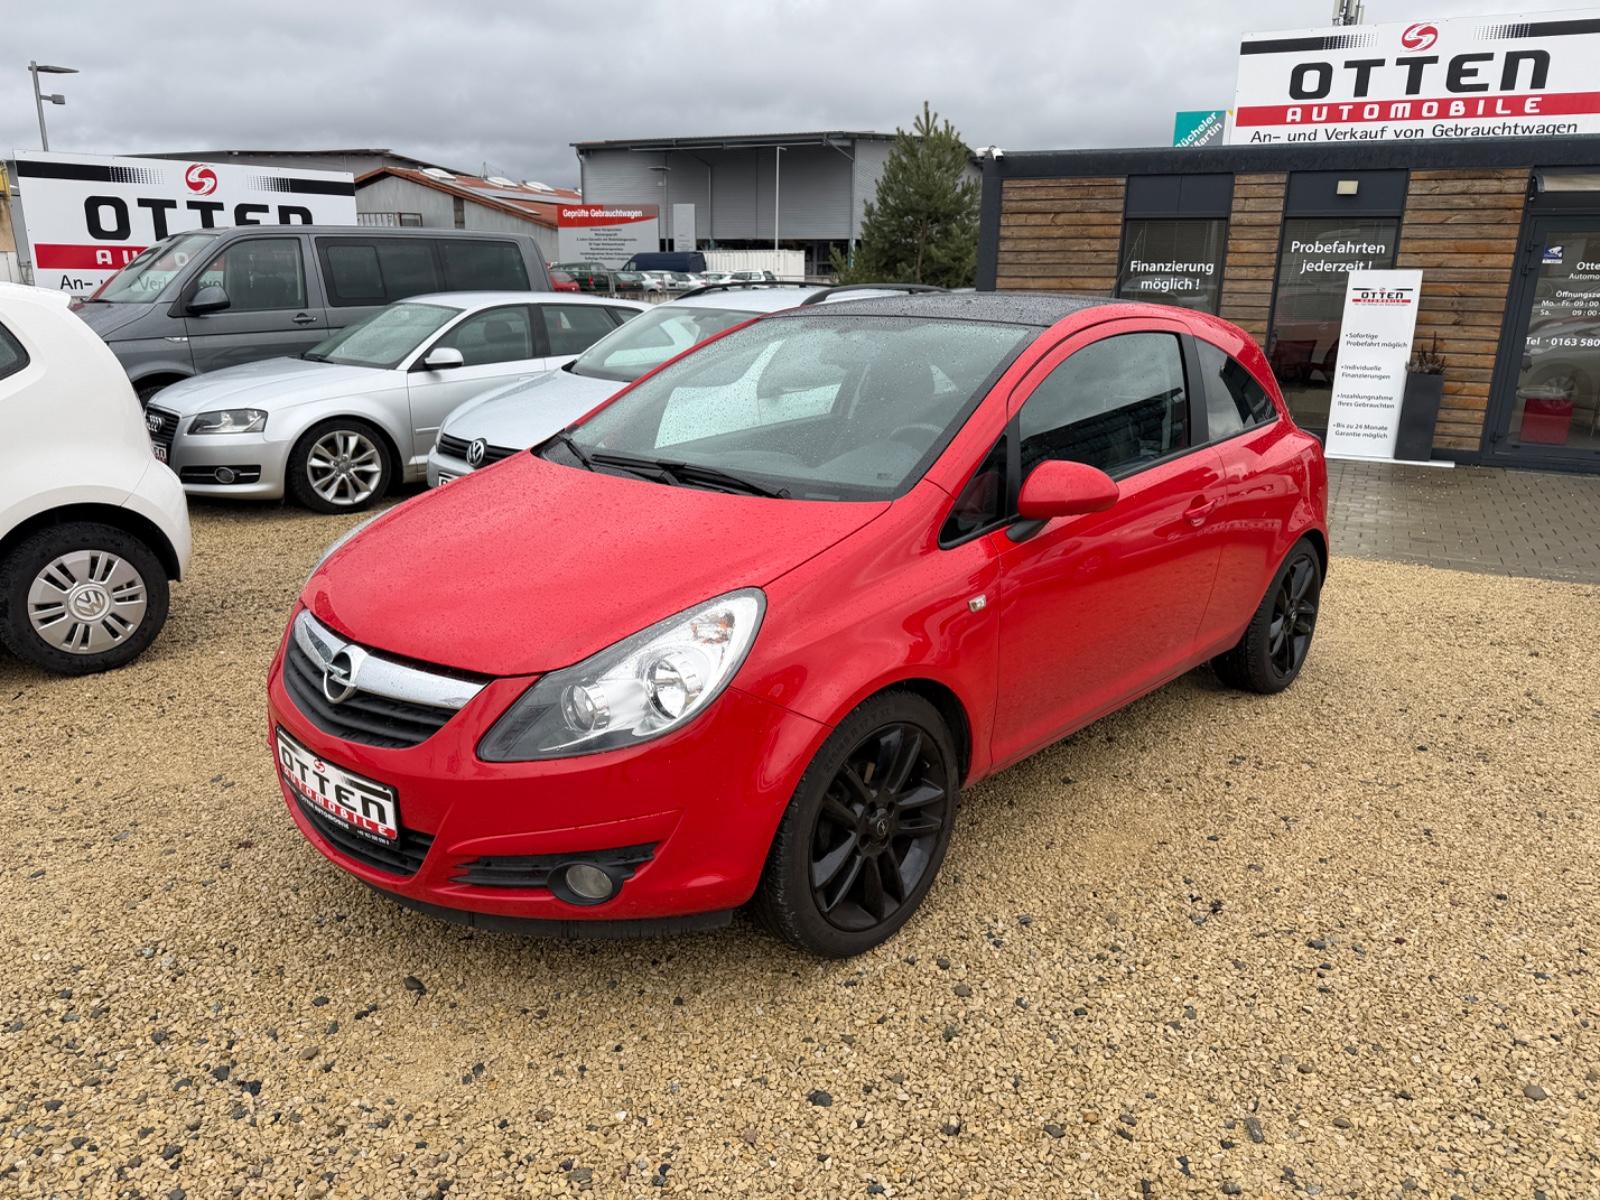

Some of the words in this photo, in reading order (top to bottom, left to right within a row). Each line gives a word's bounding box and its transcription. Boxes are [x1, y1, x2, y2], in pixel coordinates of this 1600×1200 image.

[1286, 96, 1543, 123] AUTOMOBILE
[1250, 130, 1281, 143] An-
[1287, 128, 1318, 142] und
[1325, 126, 1388, 141] Verkauf
[1393, 128, 1424, 139] von
[1432, 122, 1578, 137] Gebrauchtwagen
[590, 208, 643, 219] Gebrauchtwagen
[1291, 240, 1386, 255] Probefahrten
[1130, 260, 1215, 275] Finanzierung
[1300, 259, 1364, 274] jederzeit
[60, 274, 93, 290] An-
[1141, 277, 1194, 292] möglich
[1349, 332, 1379, 340] Sofortige
[1551, 337, 1577, 346] 0163
[1580, 338, 1600, 347] 580
[1381, 341, 1408, 349] möglich
[1341, 371, 1391, 380] Finanzierungen
[1353, 401, 1395, 409] Gebrauchten
[1362, 431, 1388, 440] möglich
